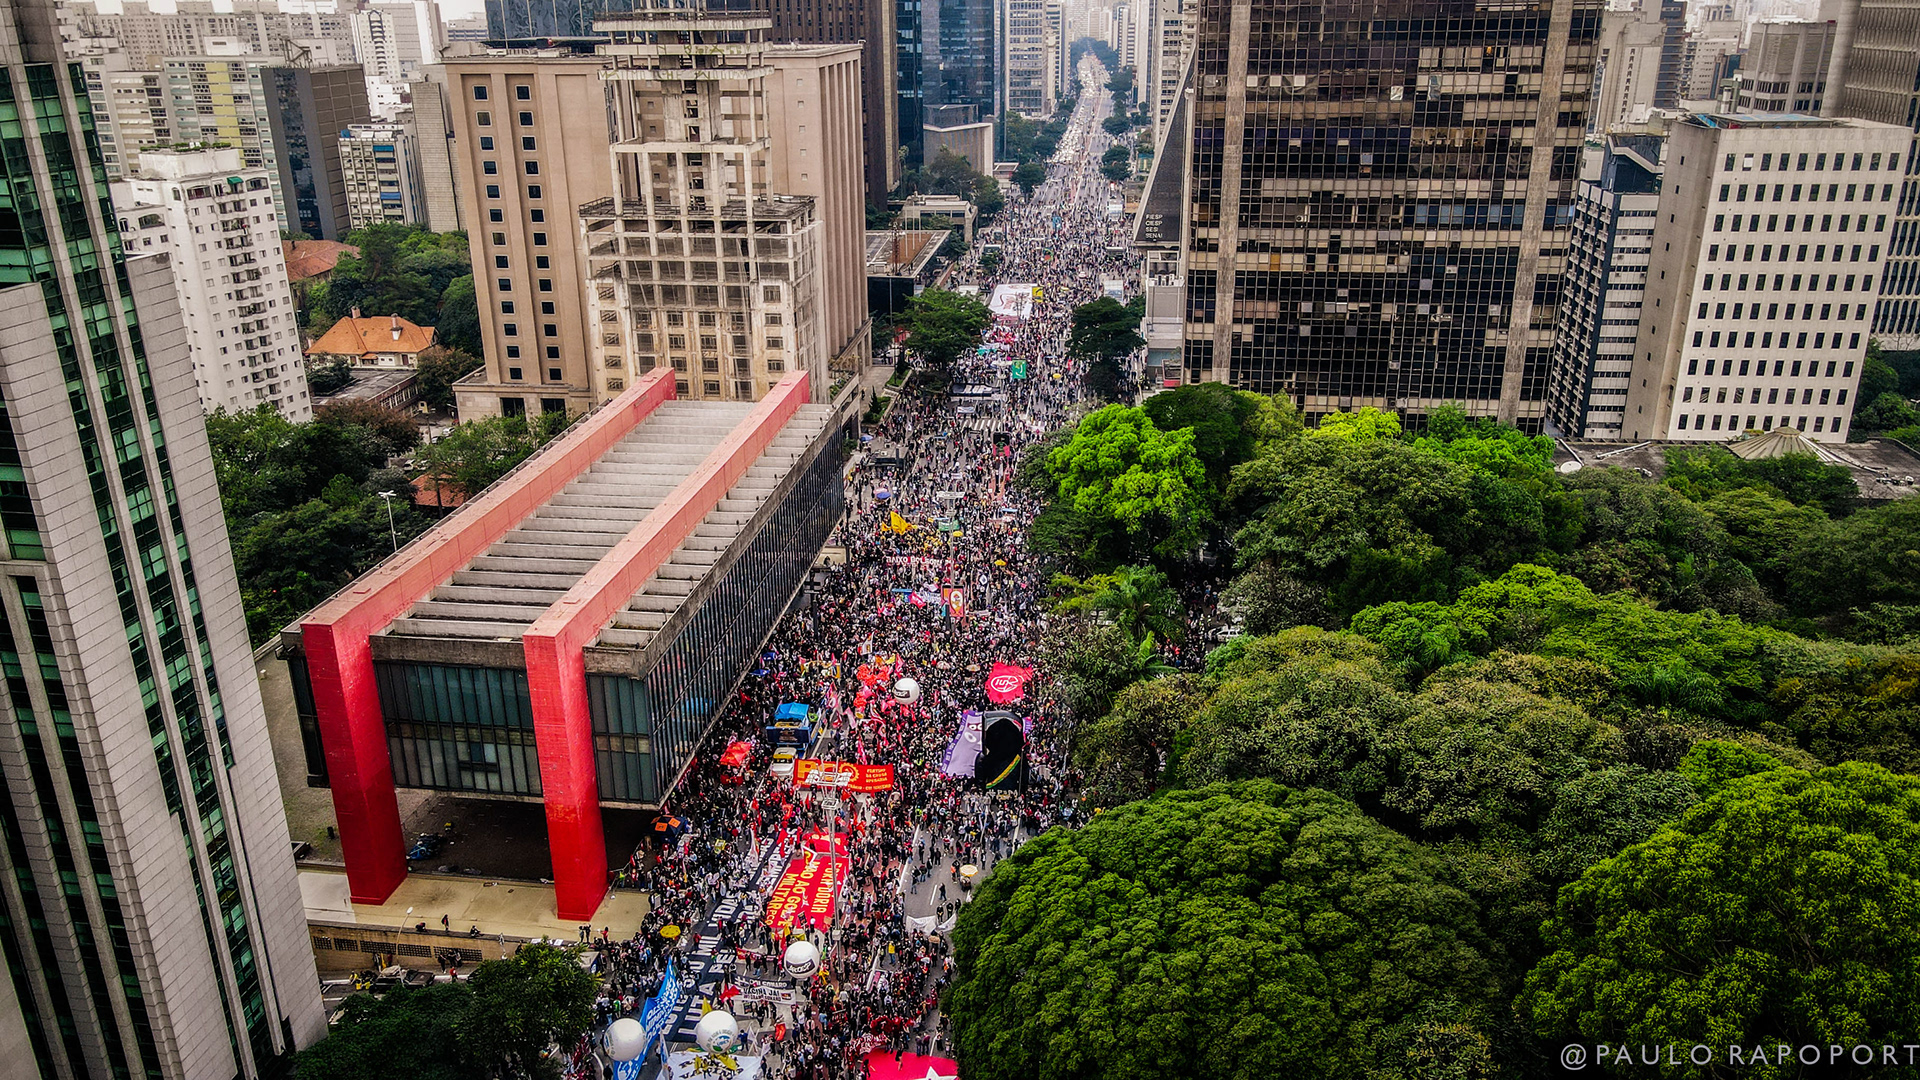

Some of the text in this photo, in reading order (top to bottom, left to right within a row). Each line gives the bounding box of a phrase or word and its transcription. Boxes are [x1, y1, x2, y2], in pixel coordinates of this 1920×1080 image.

[765, 873, 799, 926] MILITAR PCO
[792, 880, 810, 894] AO
